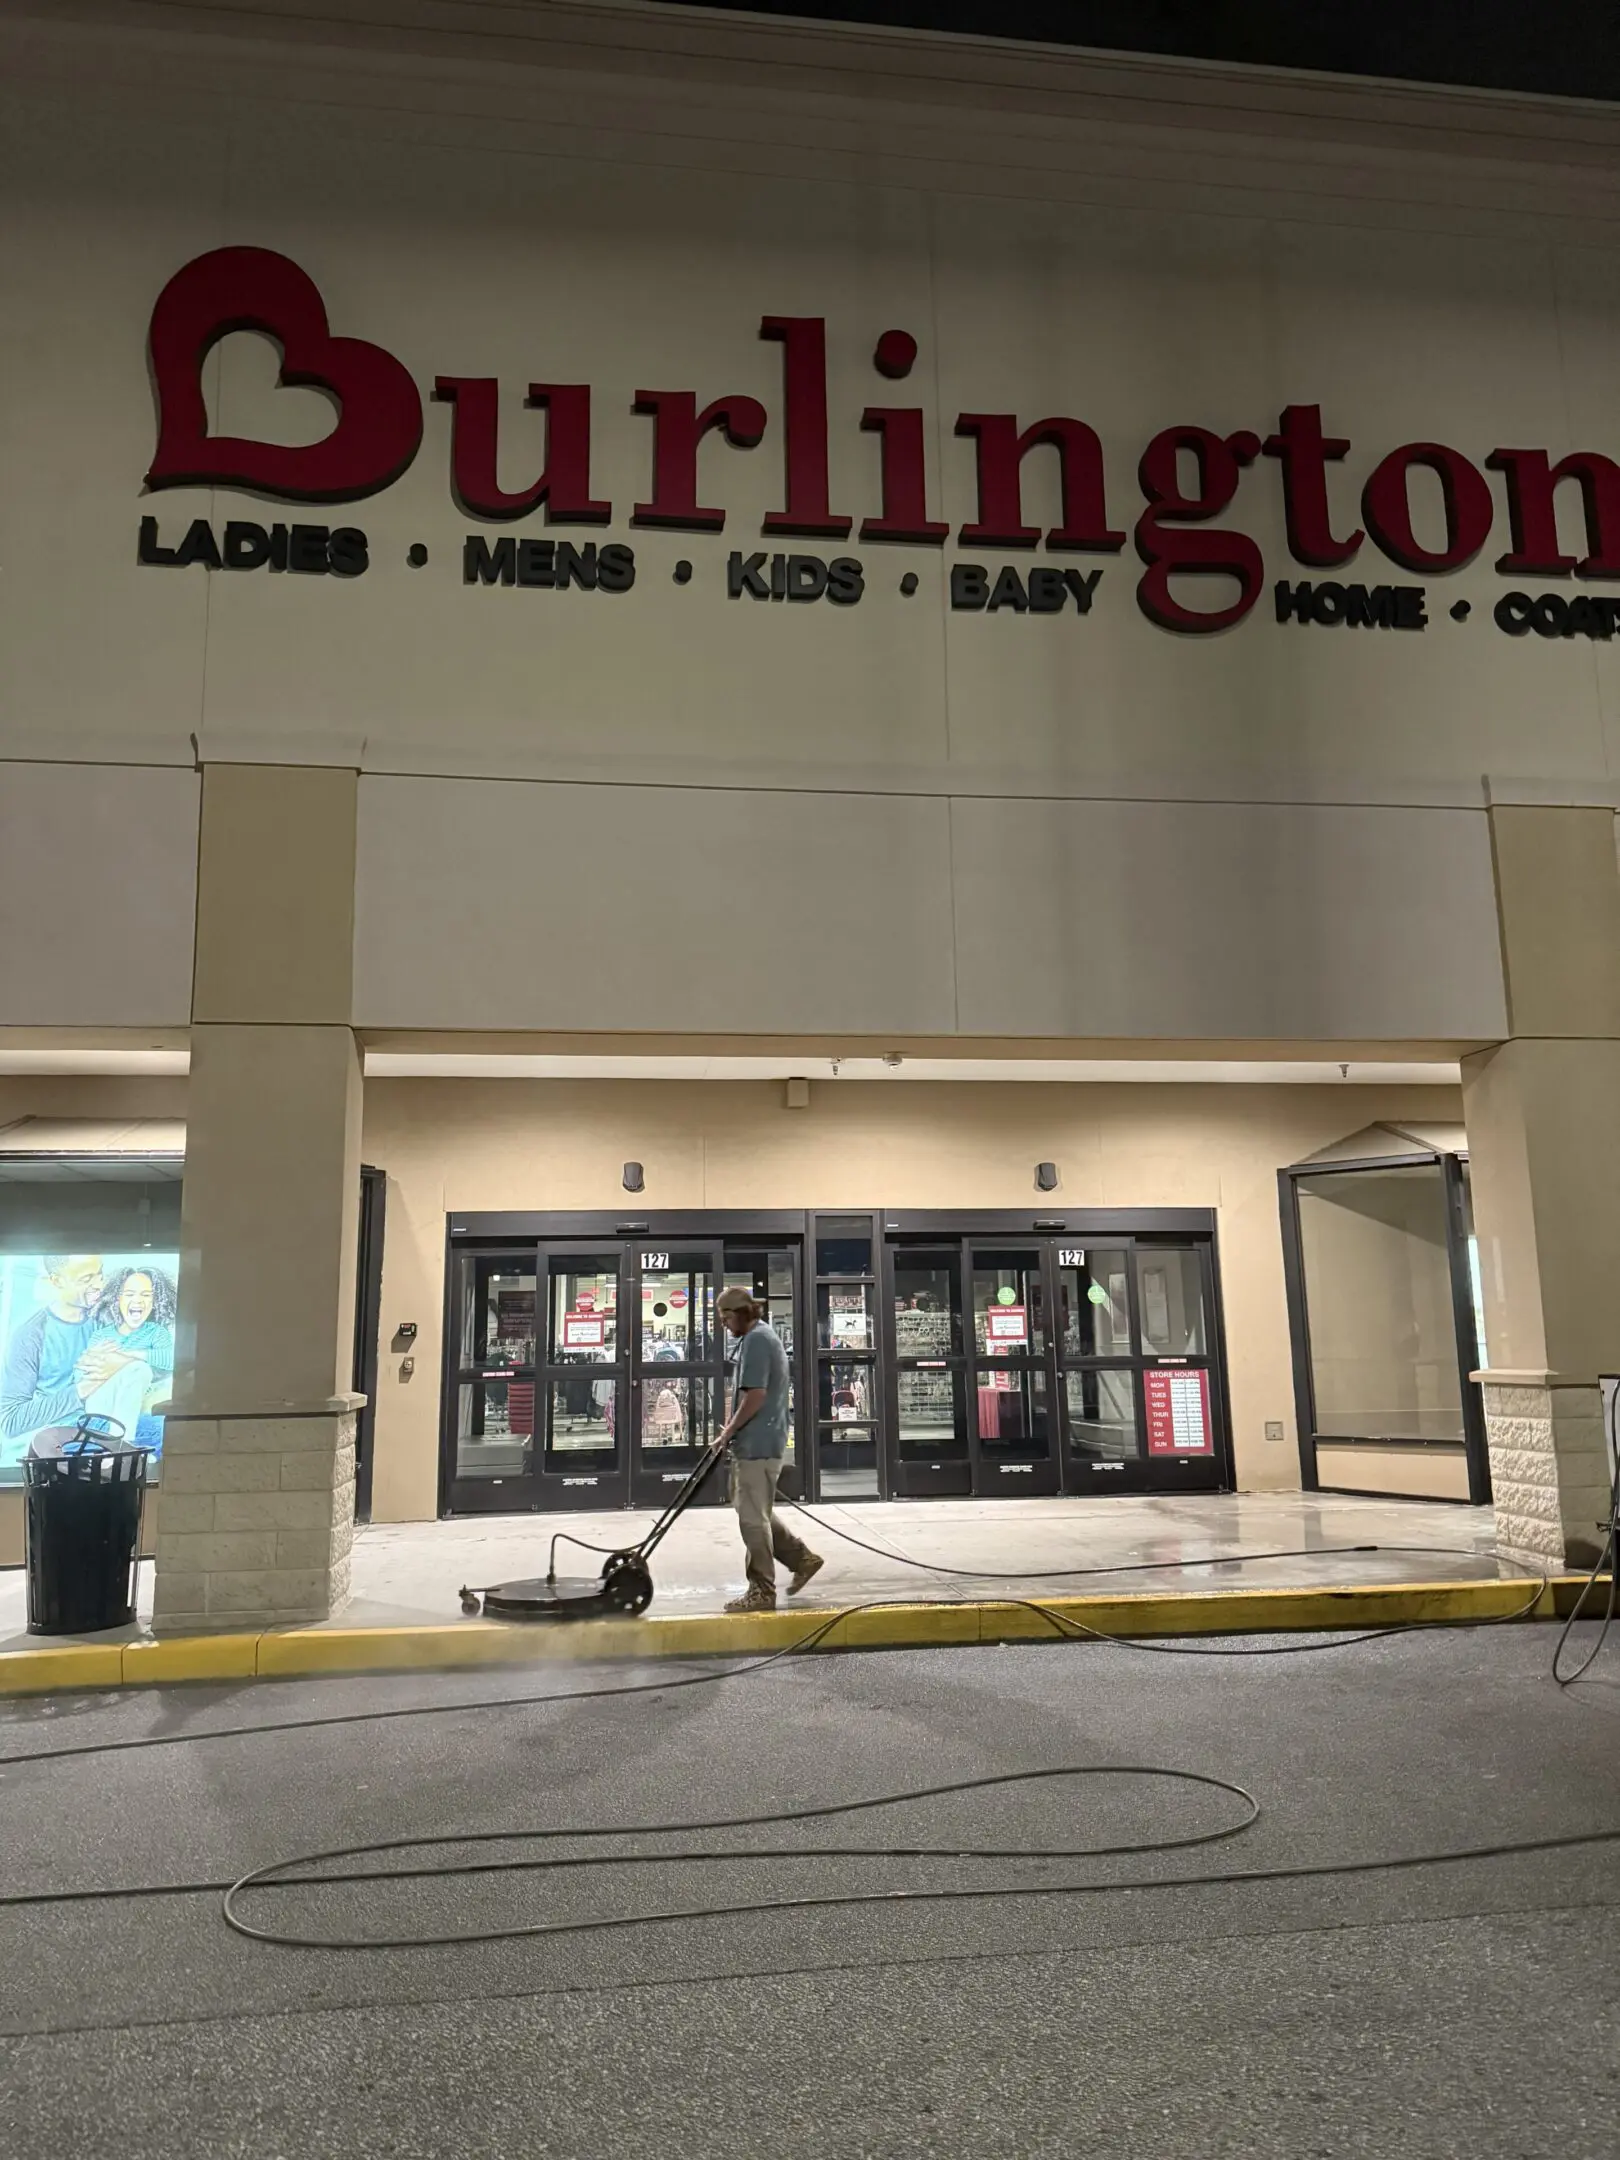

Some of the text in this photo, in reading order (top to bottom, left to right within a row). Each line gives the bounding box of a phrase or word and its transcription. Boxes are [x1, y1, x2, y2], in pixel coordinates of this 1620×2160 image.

[139, 516, 1620, 641] LADIES MENS KIDS BABY HOME COAT
[642, 1253, 668, 1269] 127
[1060, 1251, 1083, 1265] 127
